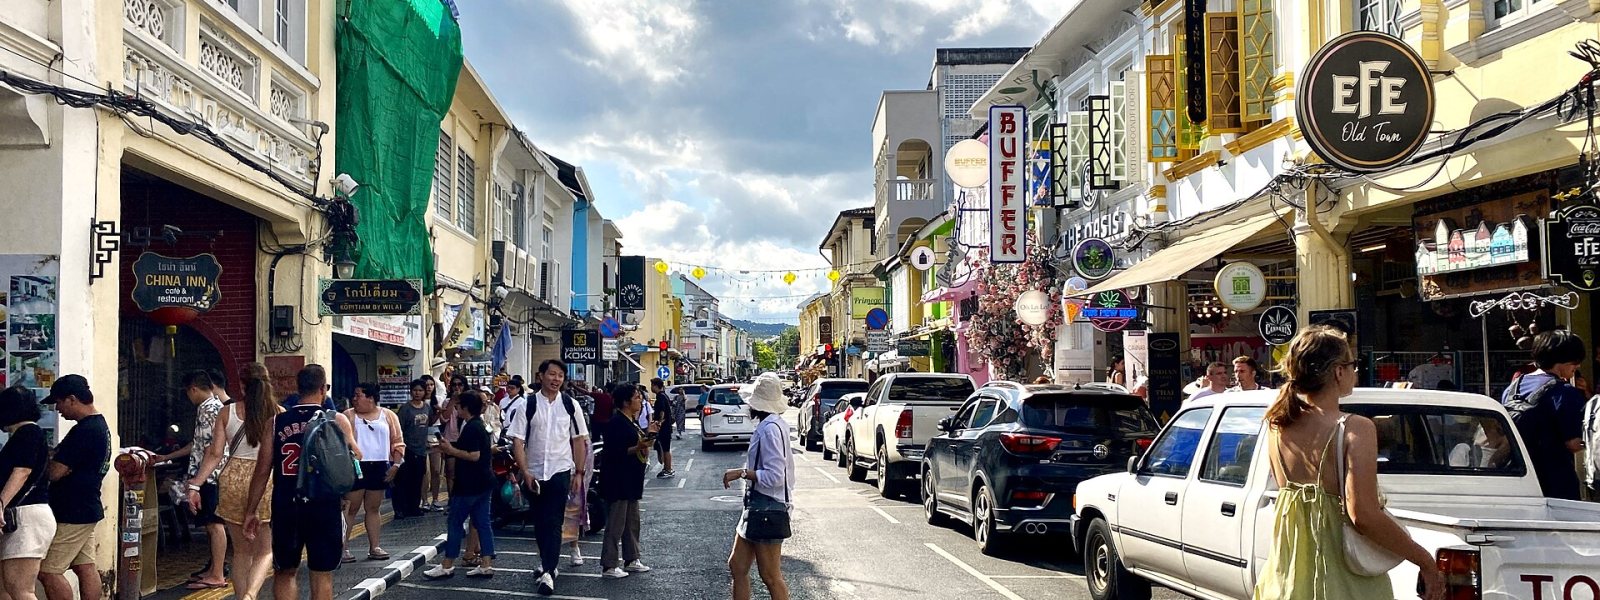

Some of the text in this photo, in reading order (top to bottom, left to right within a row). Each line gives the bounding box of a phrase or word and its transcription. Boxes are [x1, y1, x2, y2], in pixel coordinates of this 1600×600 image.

[1331, 61, 1407, 119] EFE
[1341, 121, 1401, 143] Old Town
[1000, 112, 1017, 255] BUFFER
[1060, 207, 1120, 250] THE OASIS
[1574, 237, 1600, 256] EFE
[145, 274, 207, 287] CHINA INN
[158, 295, 194, 303] restaurant
[564, 352, 596, 360] KOKU
[1520, 574, 1600, 600] TO
